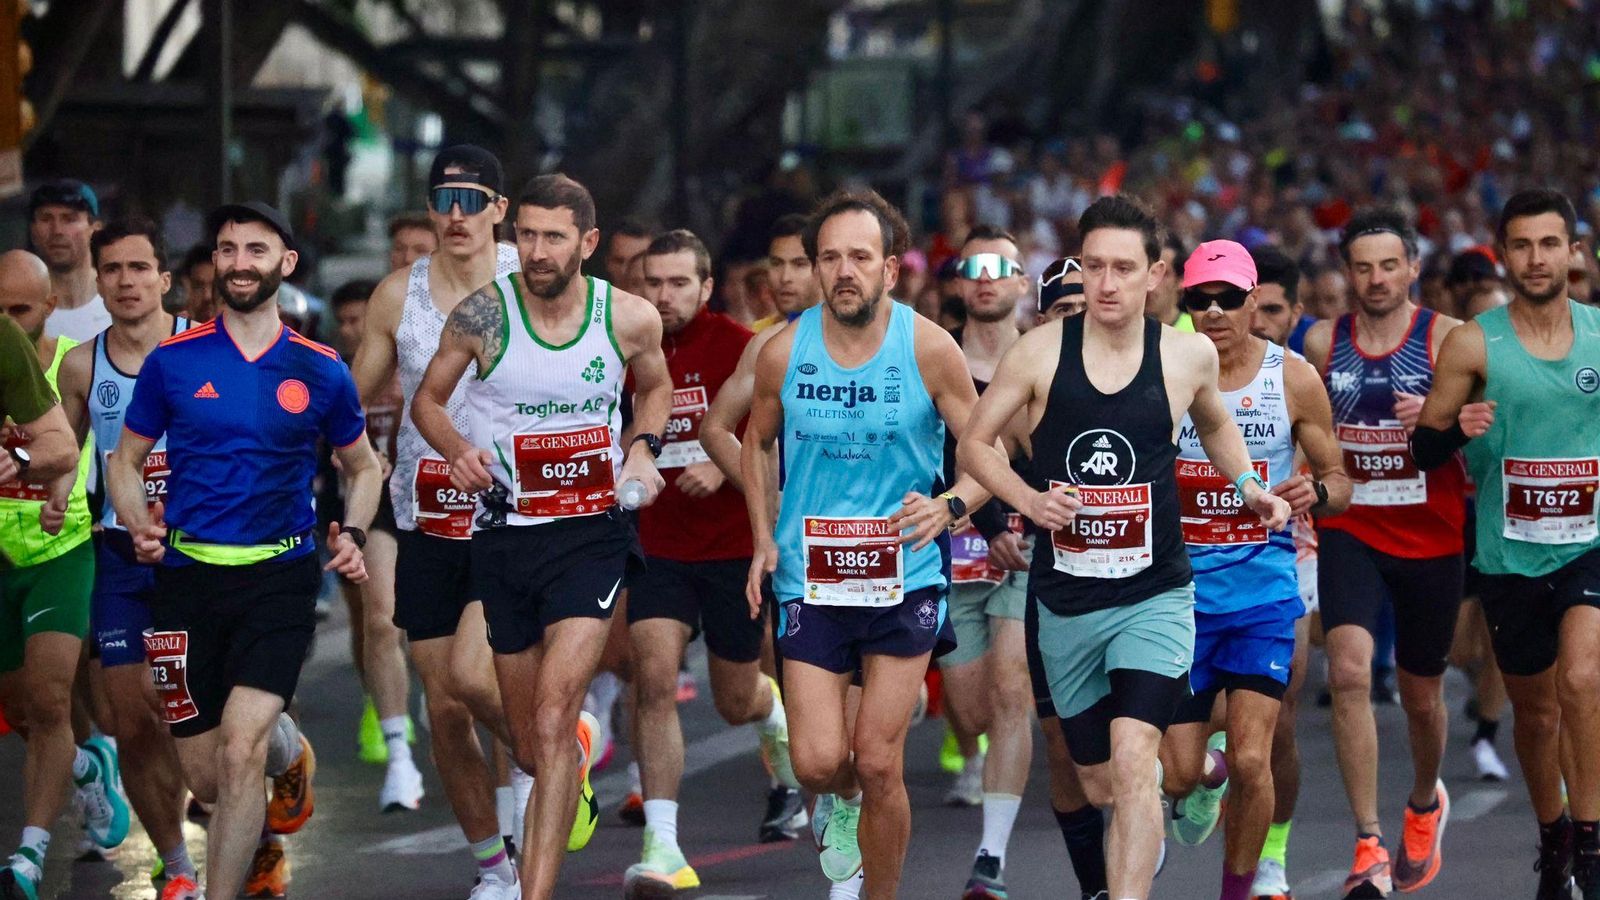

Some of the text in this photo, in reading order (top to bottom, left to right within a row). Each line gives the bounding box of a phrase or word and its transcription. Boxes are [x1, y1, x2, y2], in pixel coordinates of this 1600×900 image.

[594, 297, 604, 324] soar
[673, 392, 699, 406] RALI
[796, 380, 877, 408] nerja
[515, 397, 604, 418] Togher AC
[805, 408, 865, 420] ATLETISMO
[541, 430, 605, 449] GENERALI
[542, 460, 590, 479] 6024
[1080, 451, 1118, 476] AR
[1353, 455, 1404, 470] 13399
[1529, 463, 1593, 476] GENERALI
[145, 480, 168, 494] 92
[436, 488, 480, 503] 6243
[1080, 490, 1143, 505] ENERALI
[1196, 492, 1244, 508] 6168
[1523, 489, 1580, 506] 17672
[1201, 508, 1239, 516] MALPICA42
[828, 522, 888, 536] GENERAL
[1070, 519, 1129, 537] 15057
[823, 551, 881, 568] 13862
[144, 637, 181, 651] NERALI
